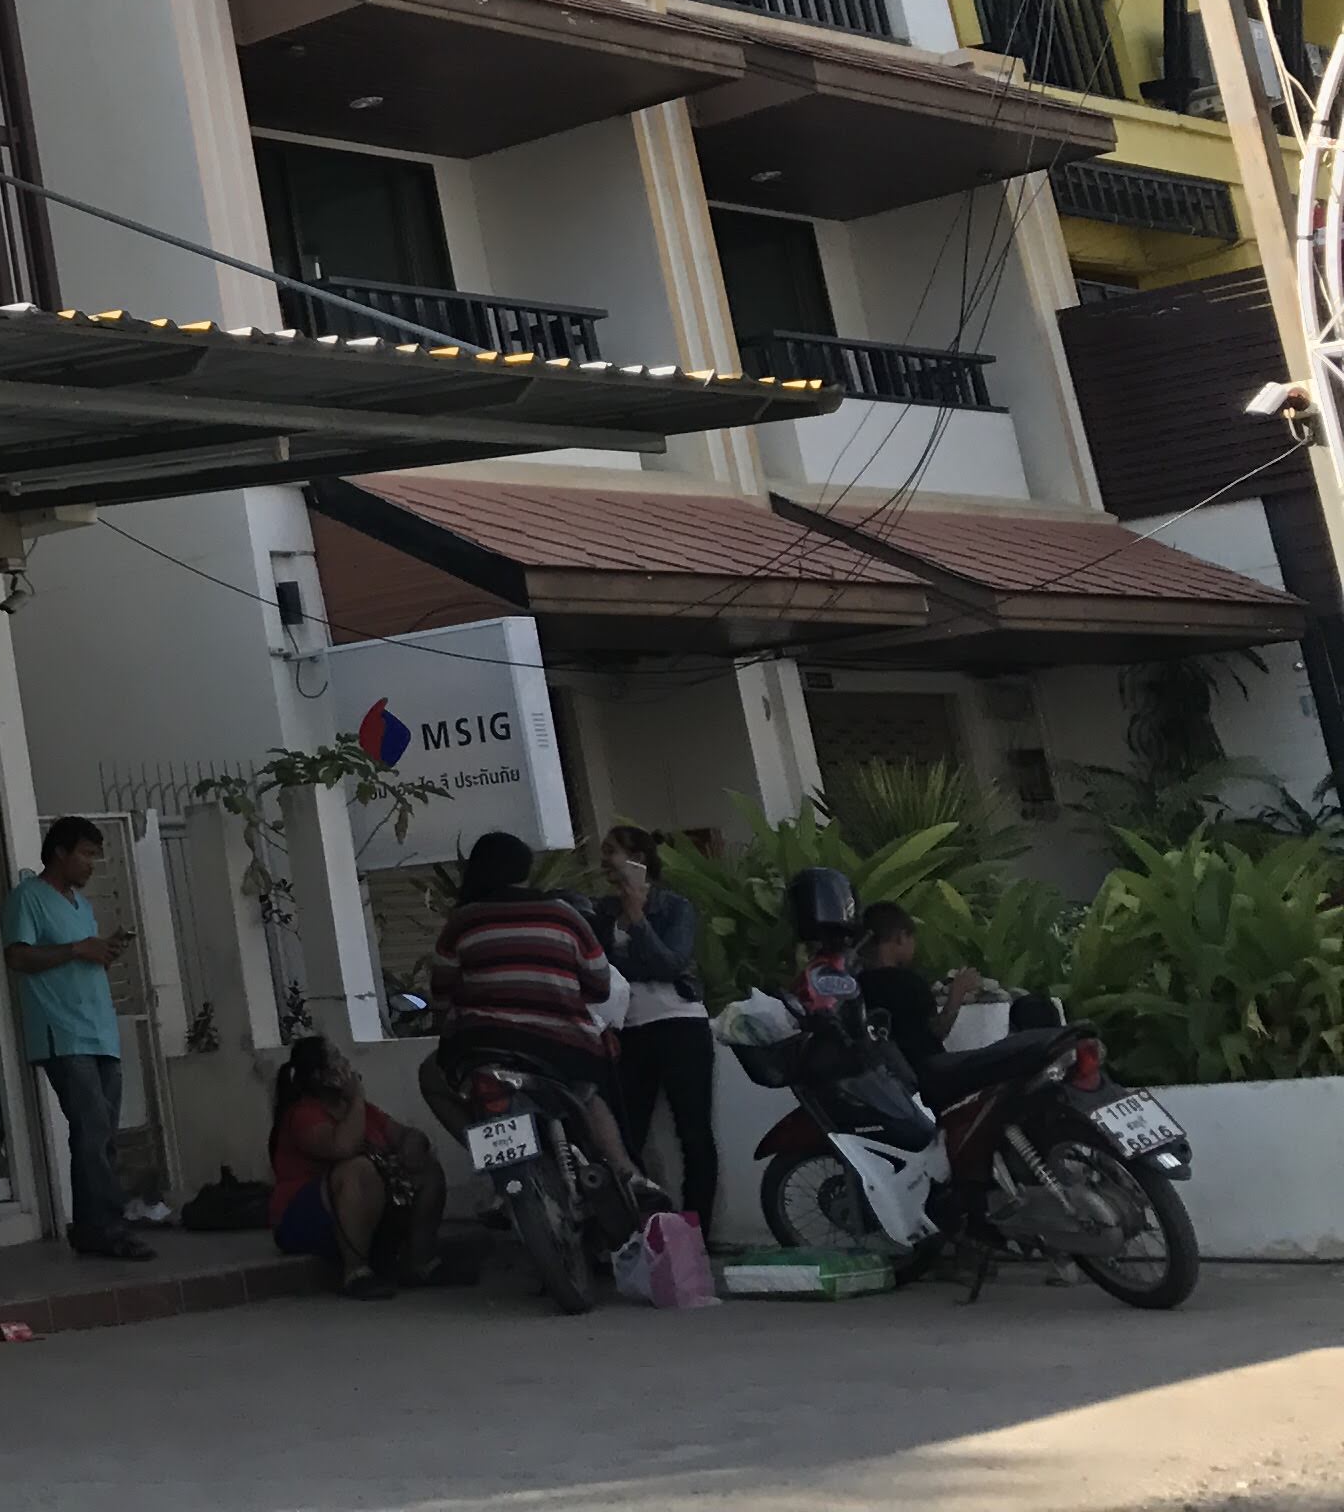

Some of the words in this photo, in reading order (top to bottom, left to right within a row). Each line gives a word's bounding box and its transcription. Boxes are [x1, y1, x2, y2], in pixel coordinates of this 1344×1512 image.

[421, 711, 512, 751] MSIG
[454, 766, 520, 790] ประกันภัย
